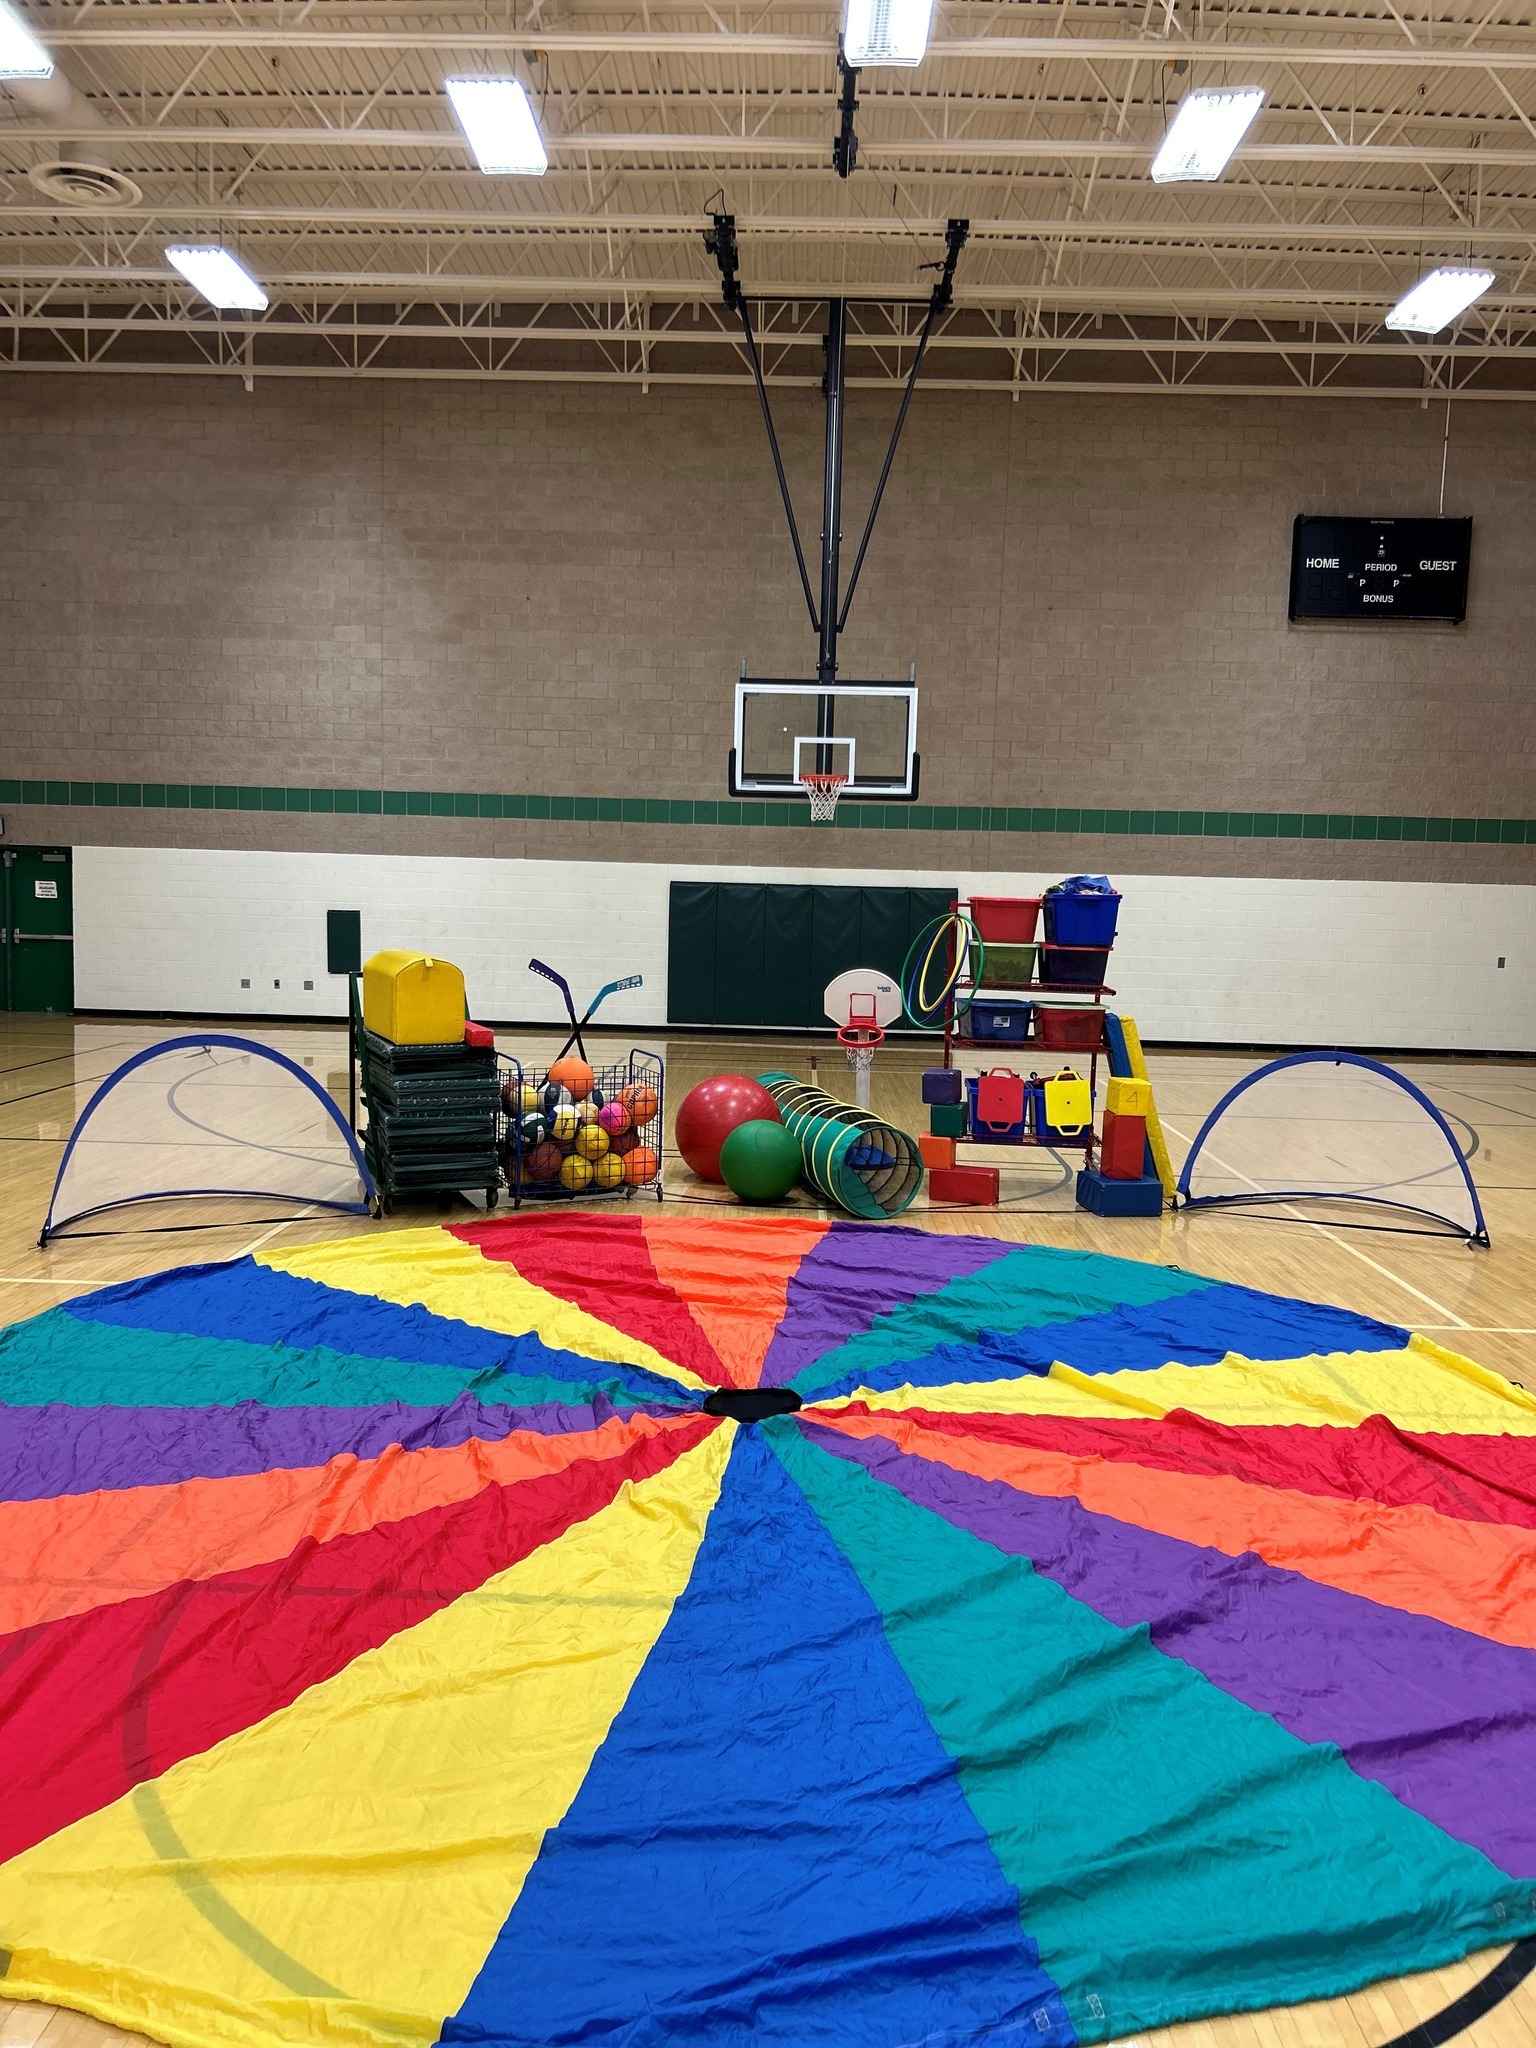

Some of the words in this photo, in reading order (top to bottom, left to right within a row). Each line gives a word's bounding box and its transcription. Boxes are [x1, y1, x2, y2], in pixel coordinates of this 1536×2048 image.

[1306, 558, 1340, 569] HOME
[1364, 563, 1398, 572] PERIOD
[1419, 560, 1457, 571] GUEST
[1359, 579, 1366, 587] P
[1393, 580, 1400, 588] P
[1363, 594, 1394, 603] BONUS
[1126, 1091, 1138, 1110] 4
